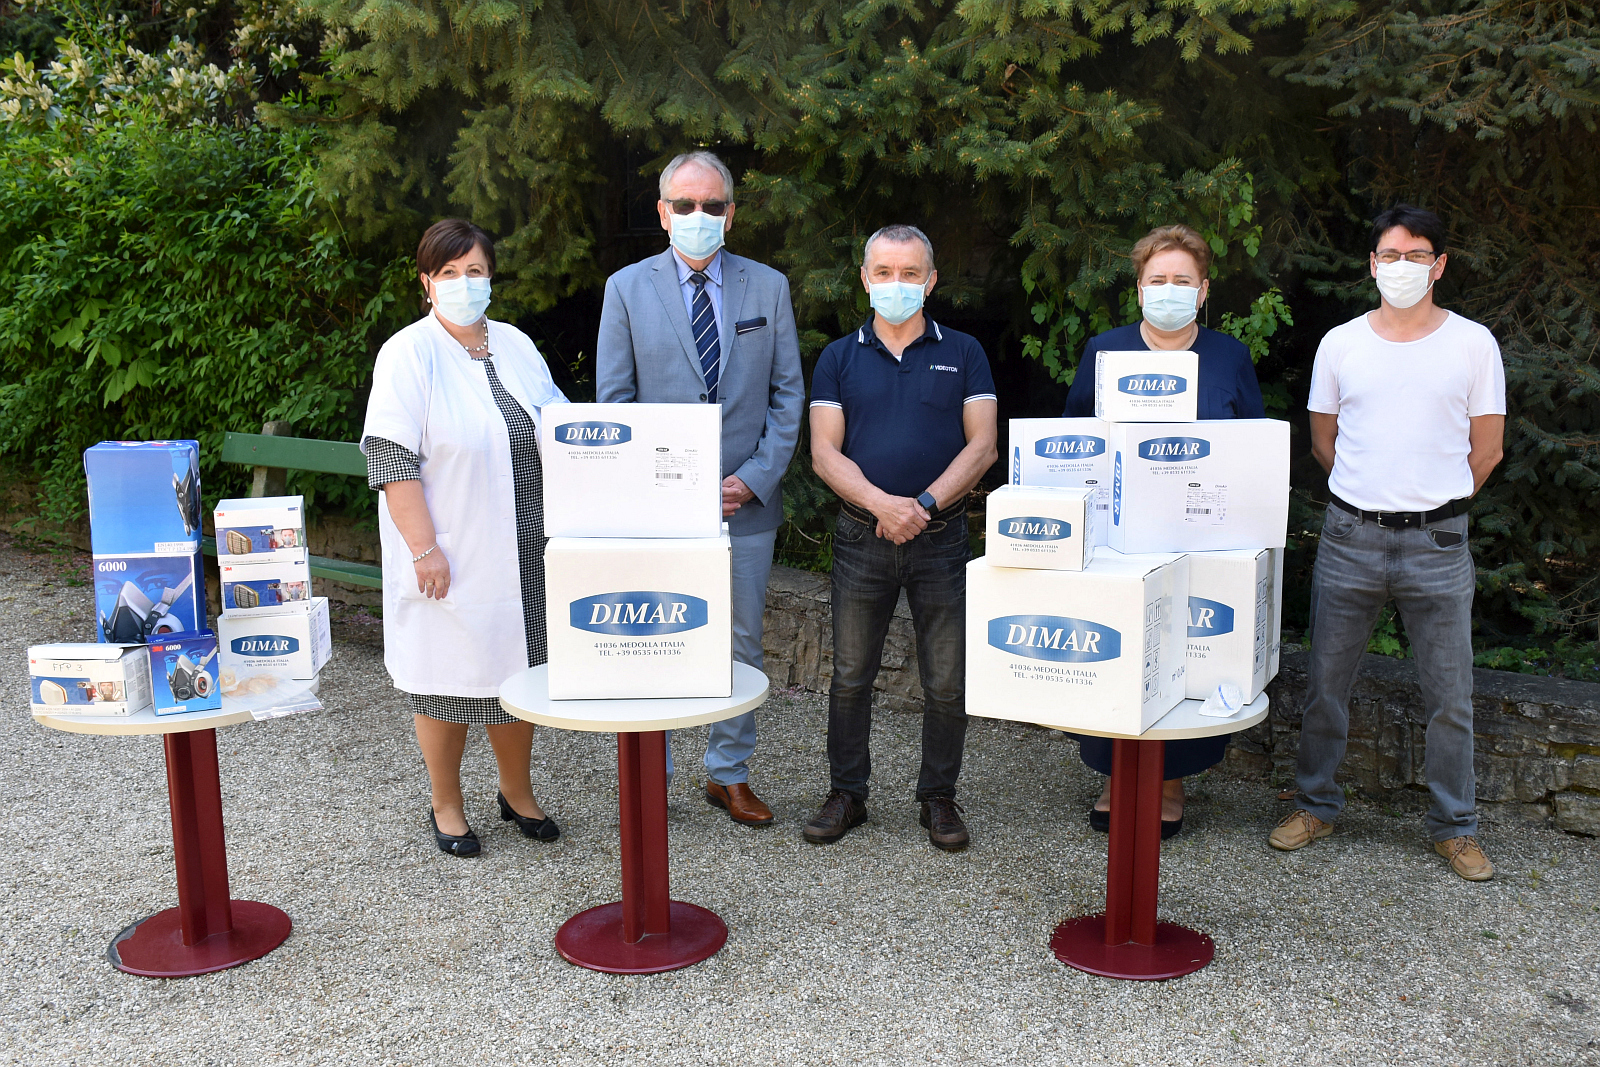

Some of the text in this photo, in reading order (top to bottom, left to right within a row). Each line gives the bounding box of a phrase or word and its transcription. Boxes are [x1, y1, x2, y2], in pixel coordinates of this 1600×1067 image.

[934, 364, 958, 373] VIDEOTON
[1126, 379, 1177, 391] DIMAR
[565, 427, 621, 440] DIMAR
[1044, 440, 1096, 454] DIMAR
[1148, 442, 1200, 456] DIMAR
[1007, 521, 1061, 536] DIMAR
[98, 561, 127, 573] 6000
[588, 602, 688, 625] DIMAR
[1005, 623, 1101, 654] DIMAR
[165, 643, 182, 652] 6000
[240, 640, 290, 652] DIMAR
[1187, 643, 1211, 652] ITALIA
[76, 663, 83, 672] 3
[1009, 663, 1097, 678] 41036 MEDOLLA ITALIA
[1013, 671, 1028, 679] TEL.
[1045, 675, 1064, 683] 0535
[1065, 677, 1093, 686] 611336
